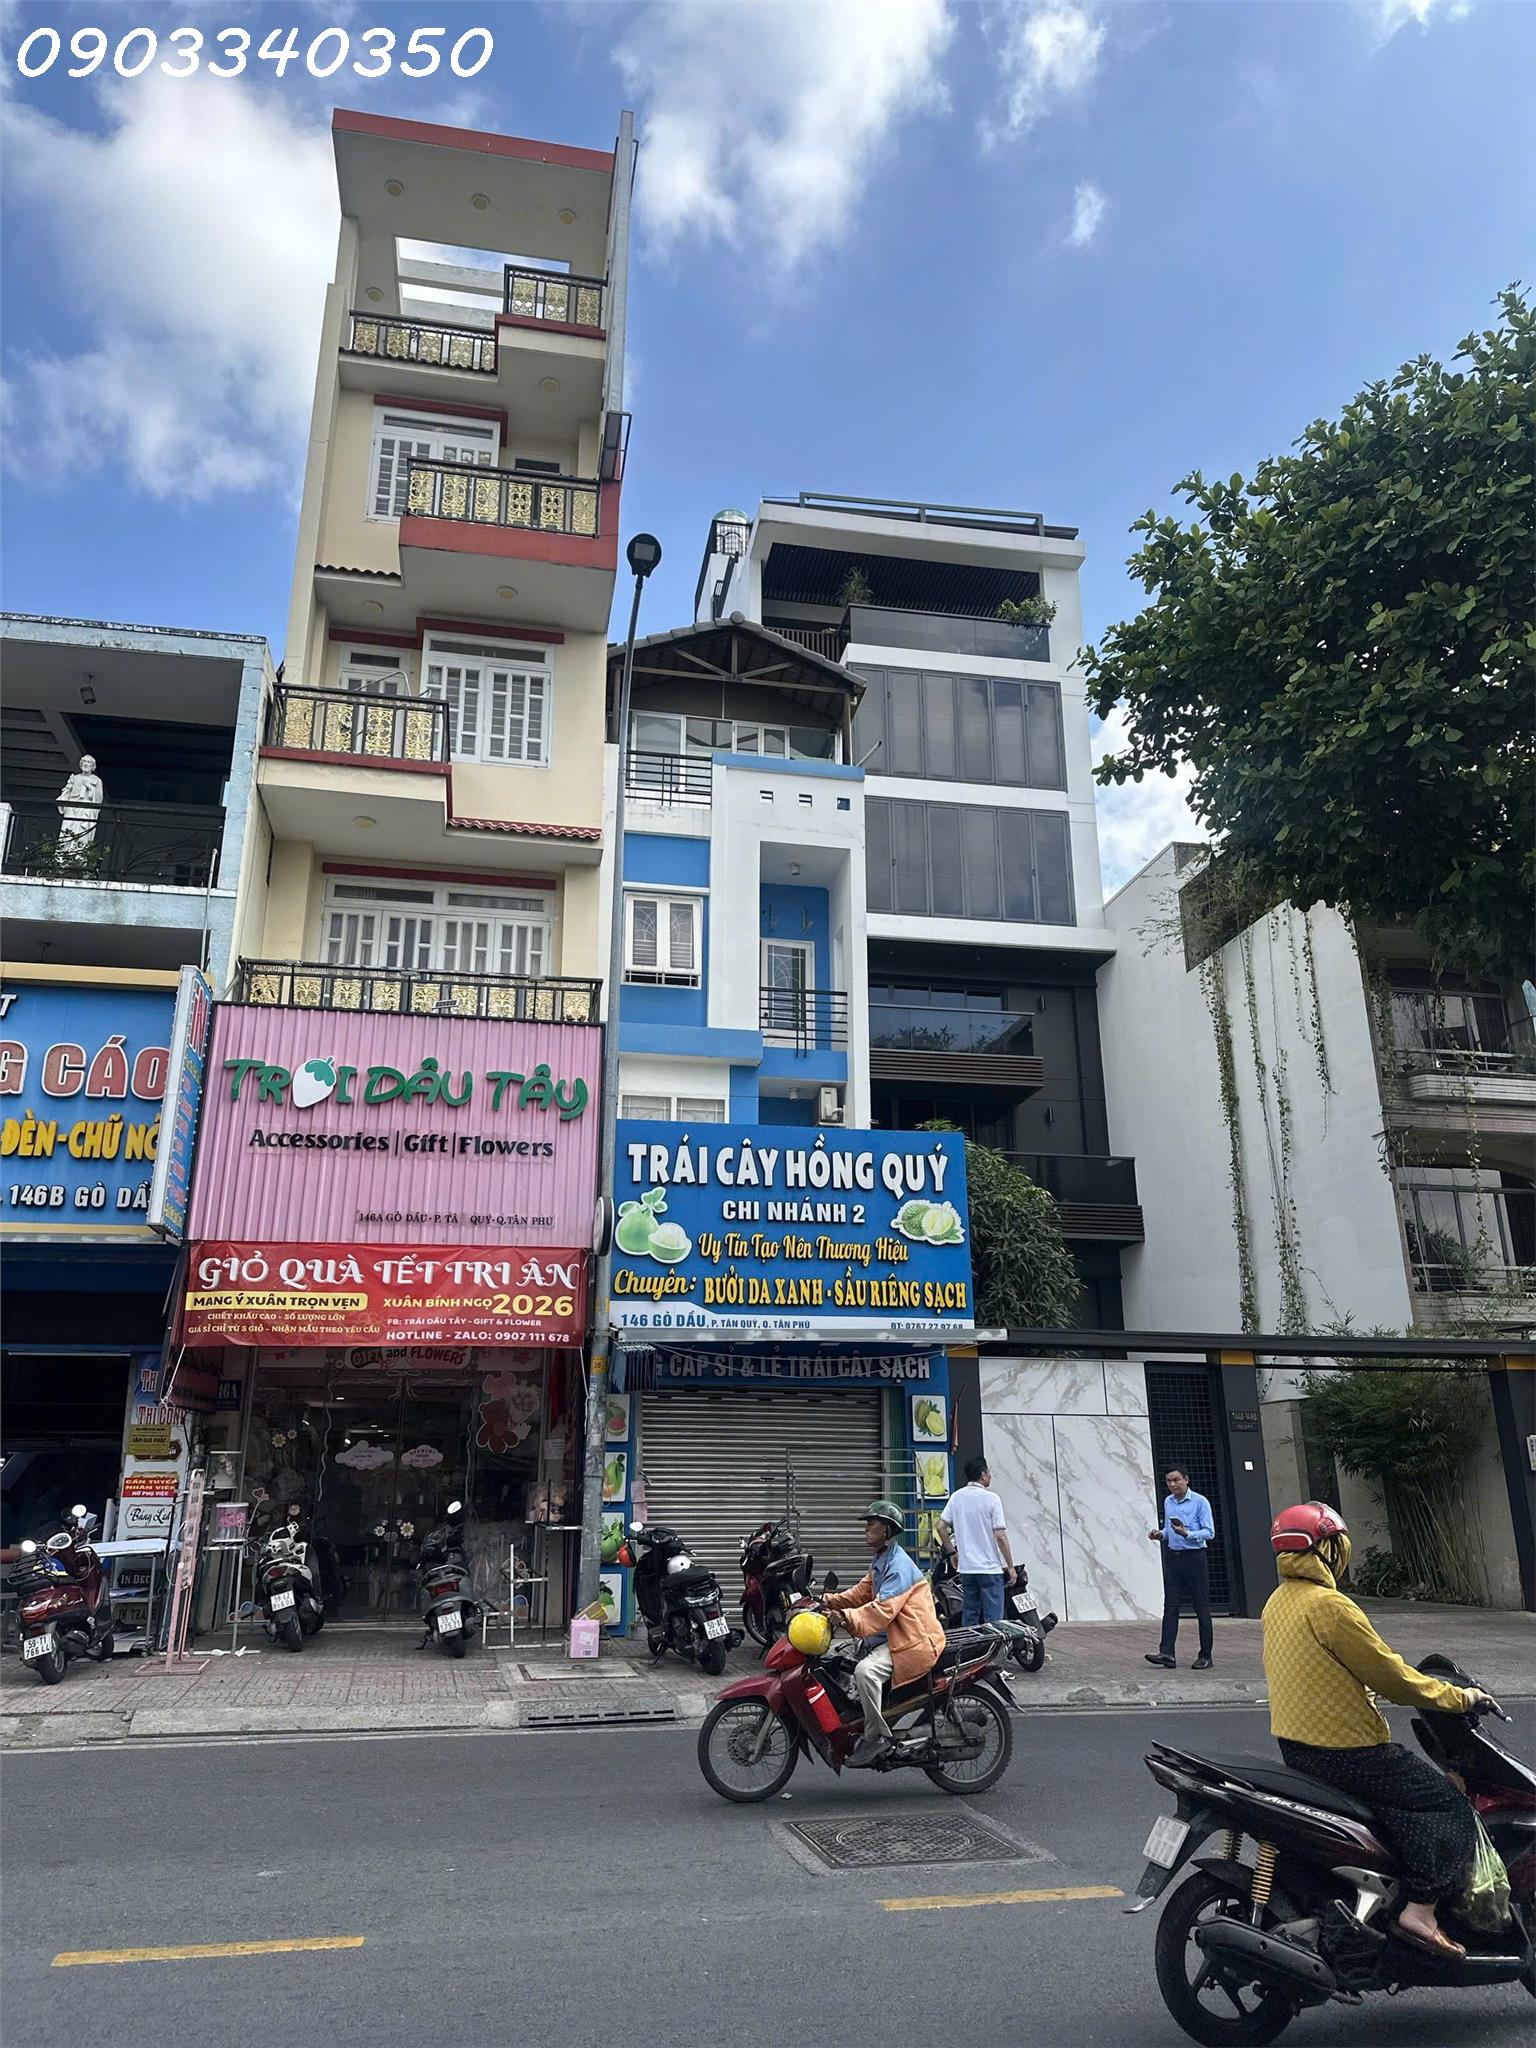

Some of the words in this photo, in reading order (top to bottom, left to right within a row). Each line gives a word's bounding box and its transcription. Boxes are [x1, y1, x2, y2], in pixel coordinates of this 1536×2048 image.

[41, 1034, 170, 1100] CÁO
[363, 1057, 474, 1107] DÂU
[486, 1063, 589, 1121] TÂY
[249, 1129, 389, 1150] Accessories
[403, 1133, 449, 1153] Gift
[459, 1135, 554, 1156] Flowers
[628, 1133, 709, 1184] TRÁI
[716, 1138, 779, 1187] CÂY
[785, 1133, 874, 1190] HỒNG
[881, 1143, 948, 1200] QUÝ
[9, 1184, 64, 1207] 146B
[74, 1181, 106, 1208] GÒ
[116, 1179, 150, 1208] DẦ
[359, 1213, 383, 1222] 146A
[386, 1211, 402, 1222] GÒ
[532, 1215, 554, 1226] PHÚ
[722, 1199, 760, 1221] CHI
[767, 1196, 846, 1223] NHÁNH
[852, 1203, 865, 1224] 2
[698, 1233, 722, 1264] Uy
[724, 1232, 749, 1257] Tín
[751, 1233, 780, 1263] Tạo
[783, 1235, 813, 1260] Nên
[816, 1235, 872, 1267] Thương
[875, 1237, 910, 1265] Hiệu
[198, 1251, 269, 1290] GIỎ
[279, 1254, 365, 1291] QUÀ
[373, 1253, 442, 1285] TẾT
[445, 1261, 511, 1289] TRI
[516, 1257, 580, 1290] ÂN
[193, 1296, 232, 1306] MANG
[235, 1292, 245, 1306] Ý
[245, 1293, 287, 1306] XUÂN
[290, 1297, 329, 1309] TRỌN
[332, 1298, 360, 1310] VẸN
[704, 1265, 744, 1304] BƯỞI
[748, 1278, 771, 1304] DA
[774, 1278, 824, 1305] XANH
[834, 1265, 867, 1306] SẦU
[870, 1273, 921, 1308] RIÊNG
[924, 1280, 967, 1314] SẠCH
[383, 1294, 422, 1307] XUÂN
[463, 1298, 492, 1310] NGỌ
[492, 1293, 574, 1316] 2026
[320, 1325, 343, 1333] THEO
[404, 1317, 424, 1325] TRÁI
[621, 1313, 648, 1327] 146
[653, 1311, 672, 1327] GÒ
[711, 1319, 718, 1327] P.
[721, 1318, 738, 1328] TÂN
[773, 1319, 790, 1329] TÂN
[792, 1319, 811, 1329] PHÚ
[387, 1331, 443, 1340] HOTLINE
[454, 1331, 492, 1340] ZALO:
[495, 1332, 526, 1340] 0907
[529, 1333, 545, 1341] 111
[548, 1333, 570, 1342] 678
[386, 1346, 407, 1359] and
[410, 1346, 466, 1365] FLOWERS
[741, 1357, 754, 1377] &
[787, 1350, 832, 1378] TRÁI
[838, 1350, 873, 1378] CÂY
[879, 1356, 930, 1383] SẠCH
